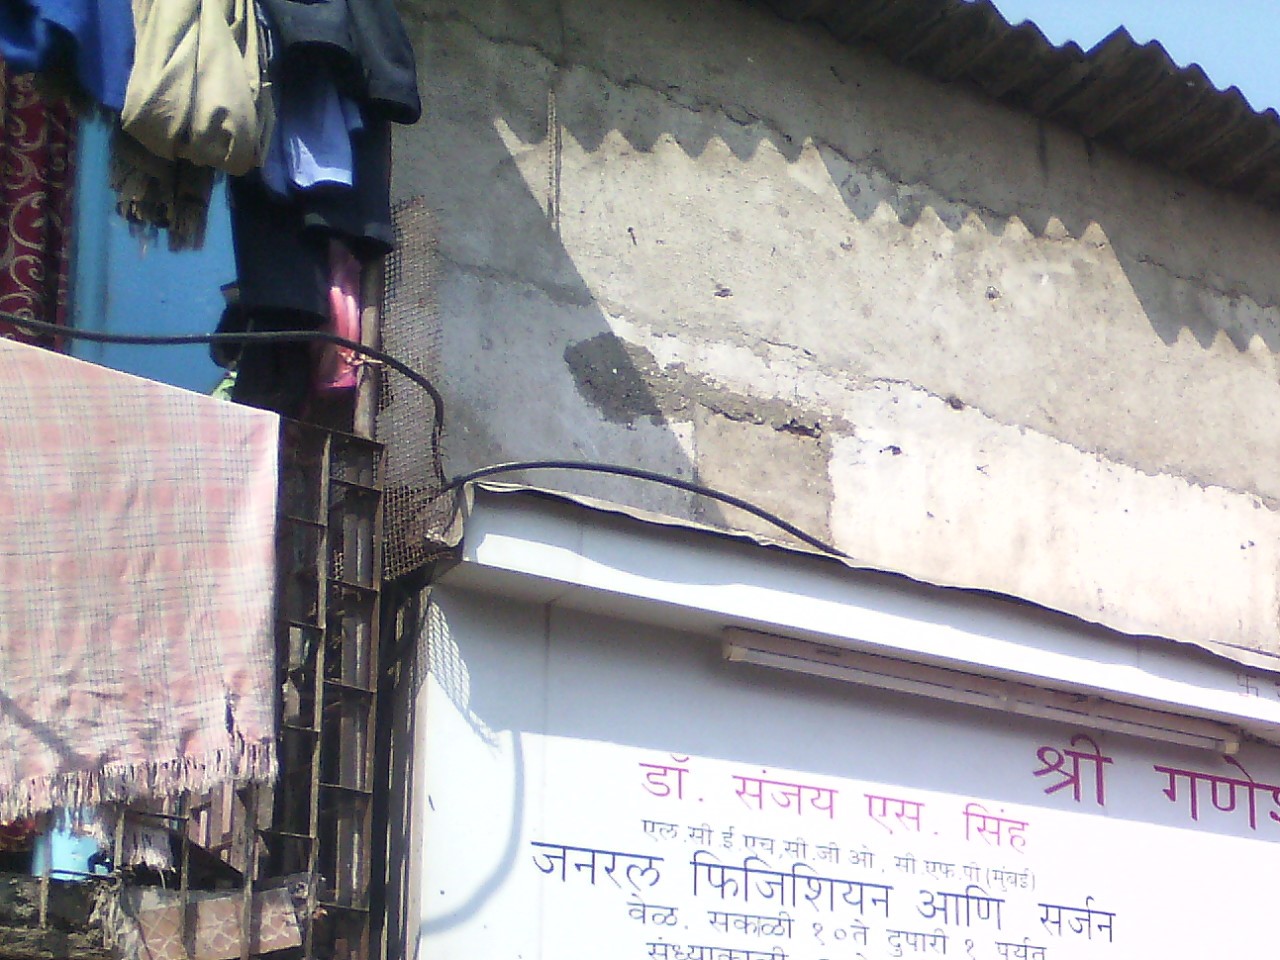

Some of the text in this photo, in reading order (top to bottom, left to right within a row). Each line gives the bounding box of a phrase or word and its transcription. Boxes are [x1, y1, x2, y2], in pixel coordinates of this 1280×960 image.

[638, 753, 1029, 854] डॉ. संजय एस. सिंह
[1033, 733, 1113, 807] श्री
[531, 841, 1116, 942] जनरल फिजिशियन आणि सर्जन
[707, 911, 795, 939] सकाळी
[886, 927, 949, 958] दुपारी
